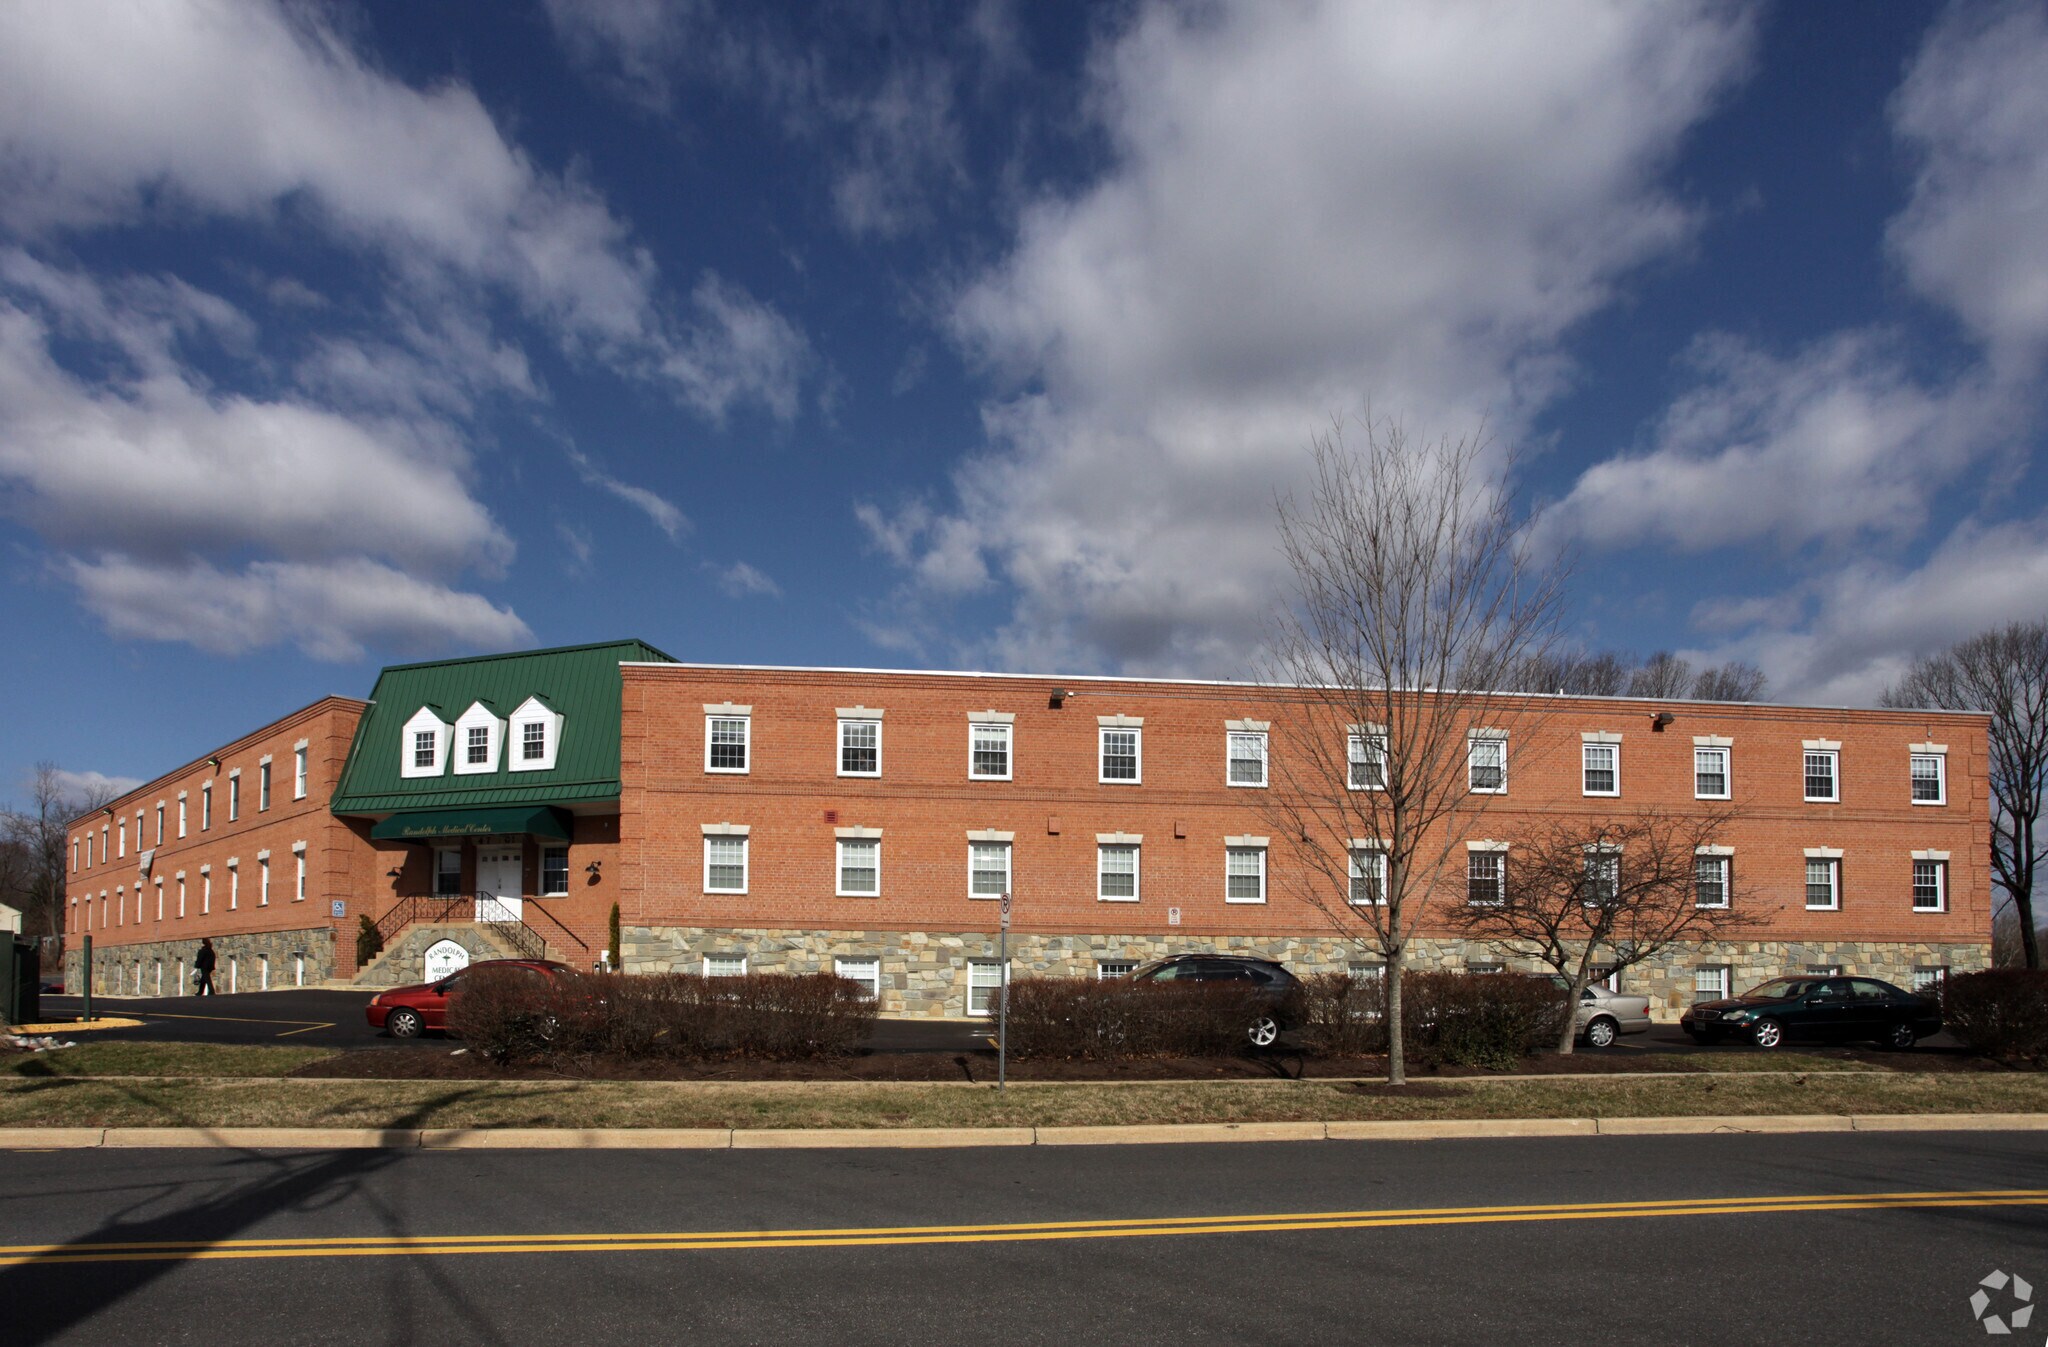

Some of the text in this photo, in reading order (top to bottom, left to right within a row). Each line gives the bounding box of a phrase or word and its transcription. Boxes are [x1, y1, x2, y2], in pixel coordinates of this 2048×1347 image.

[402, 823, 492, 836] Randolph Medical Center
[428, 946, 465, 960] RANDOLPH
